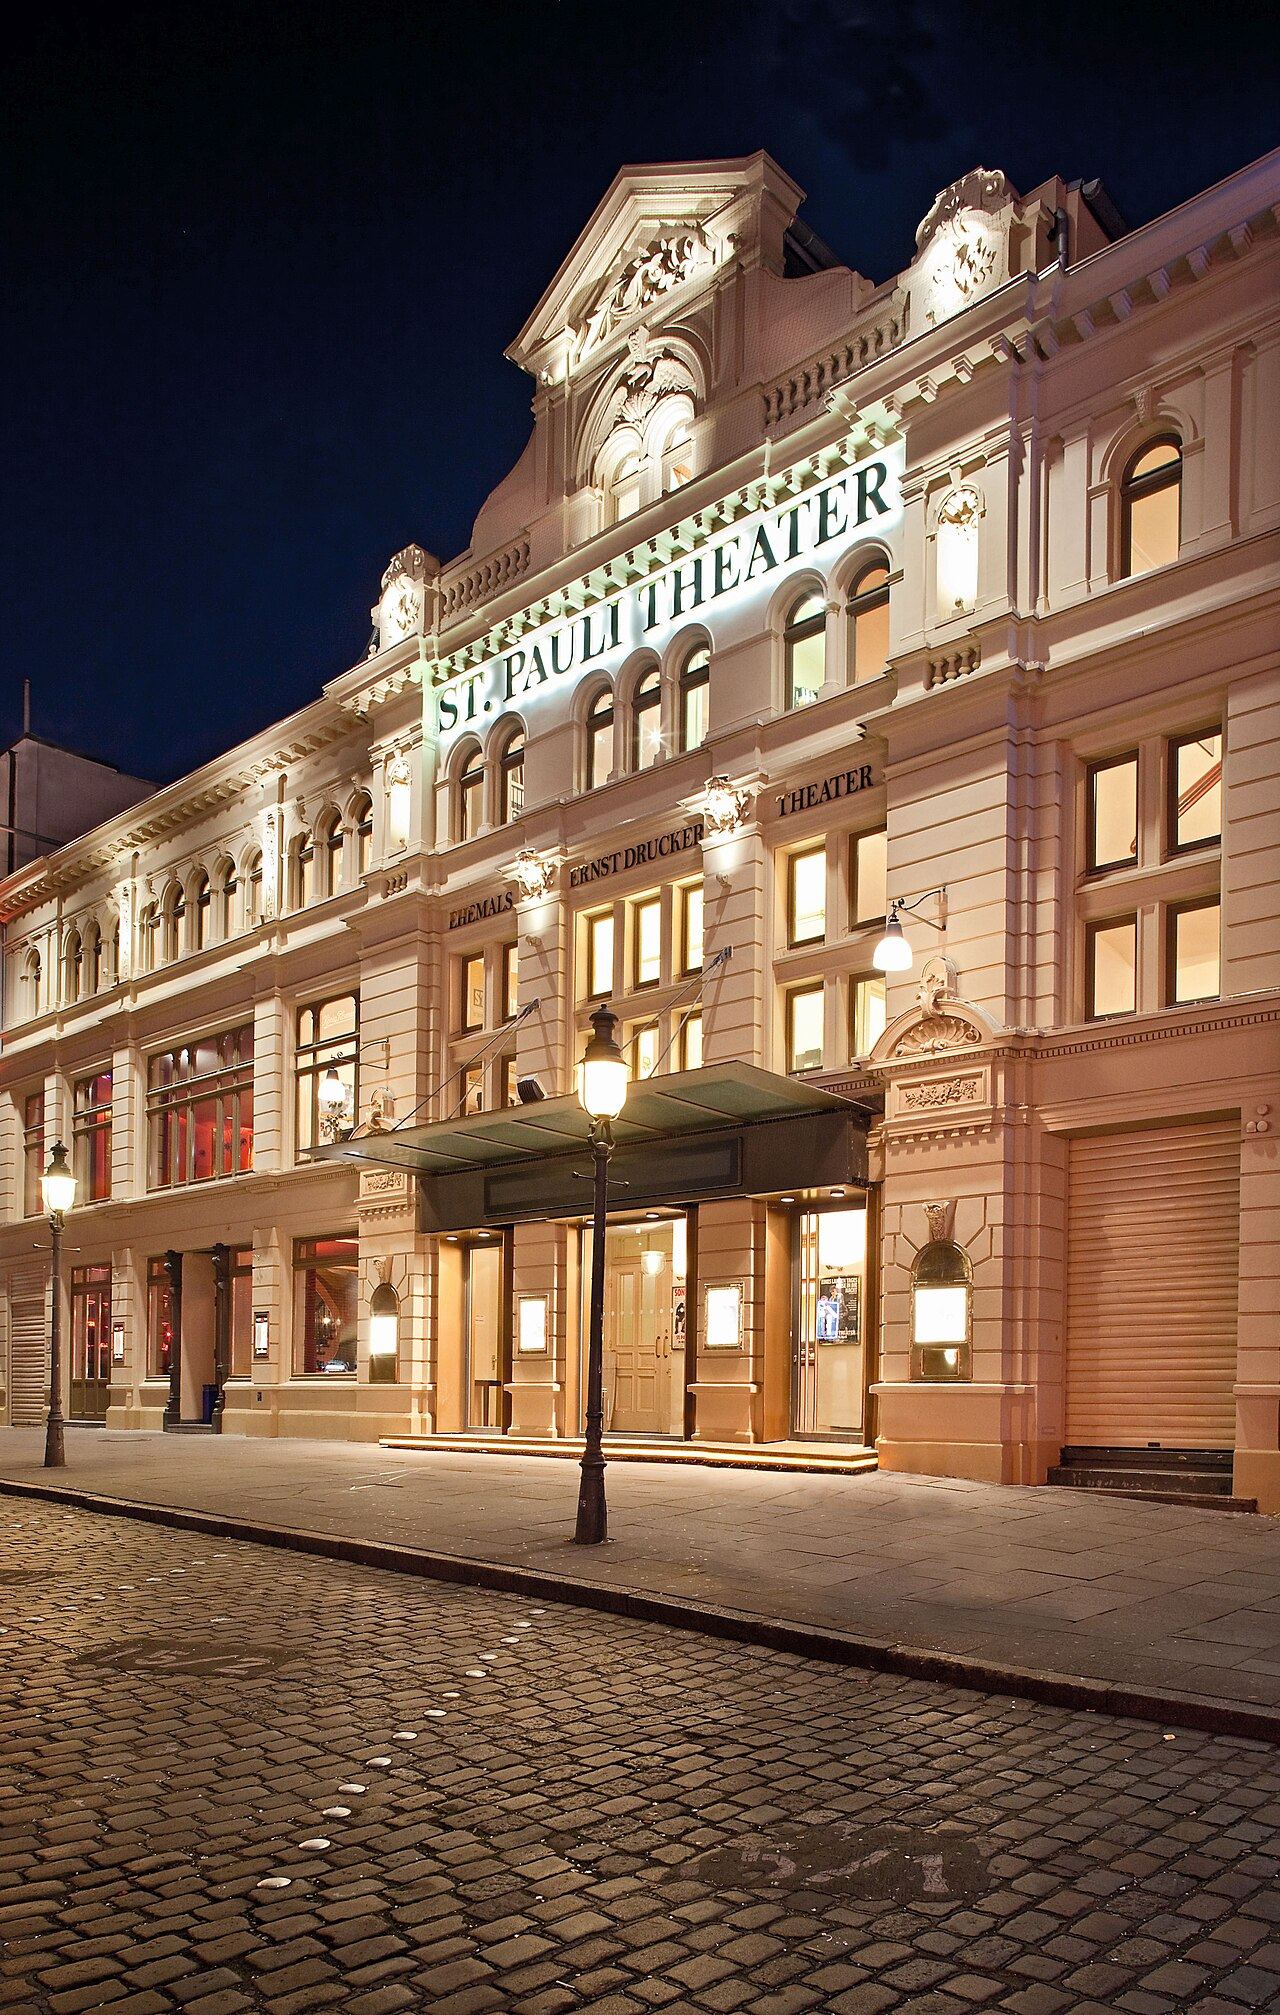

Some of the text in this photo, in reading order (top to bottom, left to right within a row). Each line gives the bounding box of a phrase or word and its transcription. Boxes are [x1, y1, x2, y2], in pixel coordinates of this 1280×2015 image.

[438, 462, 892, 734] ST. PAULI THEATER
[449, 764, 874, 930] EHEMALS ERNST DRUCKER THEATER
